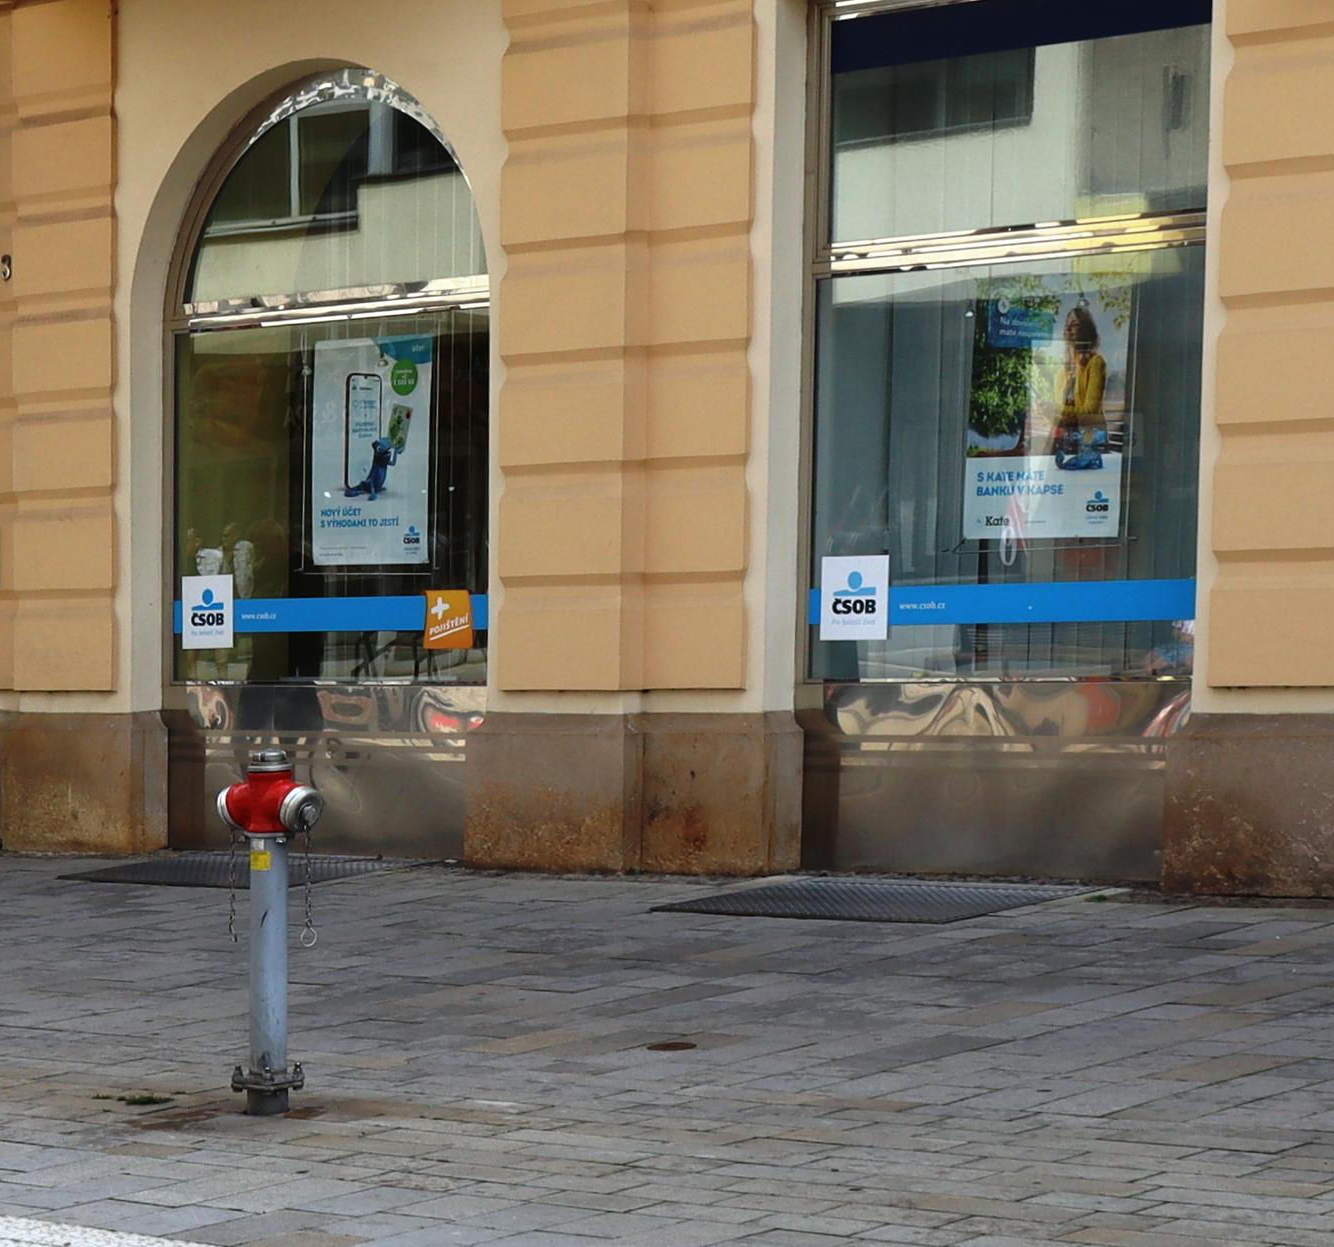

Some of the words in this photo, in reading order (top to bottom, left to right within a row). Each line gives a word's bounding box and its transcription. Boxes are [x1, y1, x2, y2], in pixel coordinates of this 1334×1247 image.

[977, 472, 984, 482] S
[987, 471, 1014, 481] KATE
[977, 485, 1014, 496] BANKU
[832, 598, 876, 614] ČSOB
[191, 613, 224, 626] ČSOB
